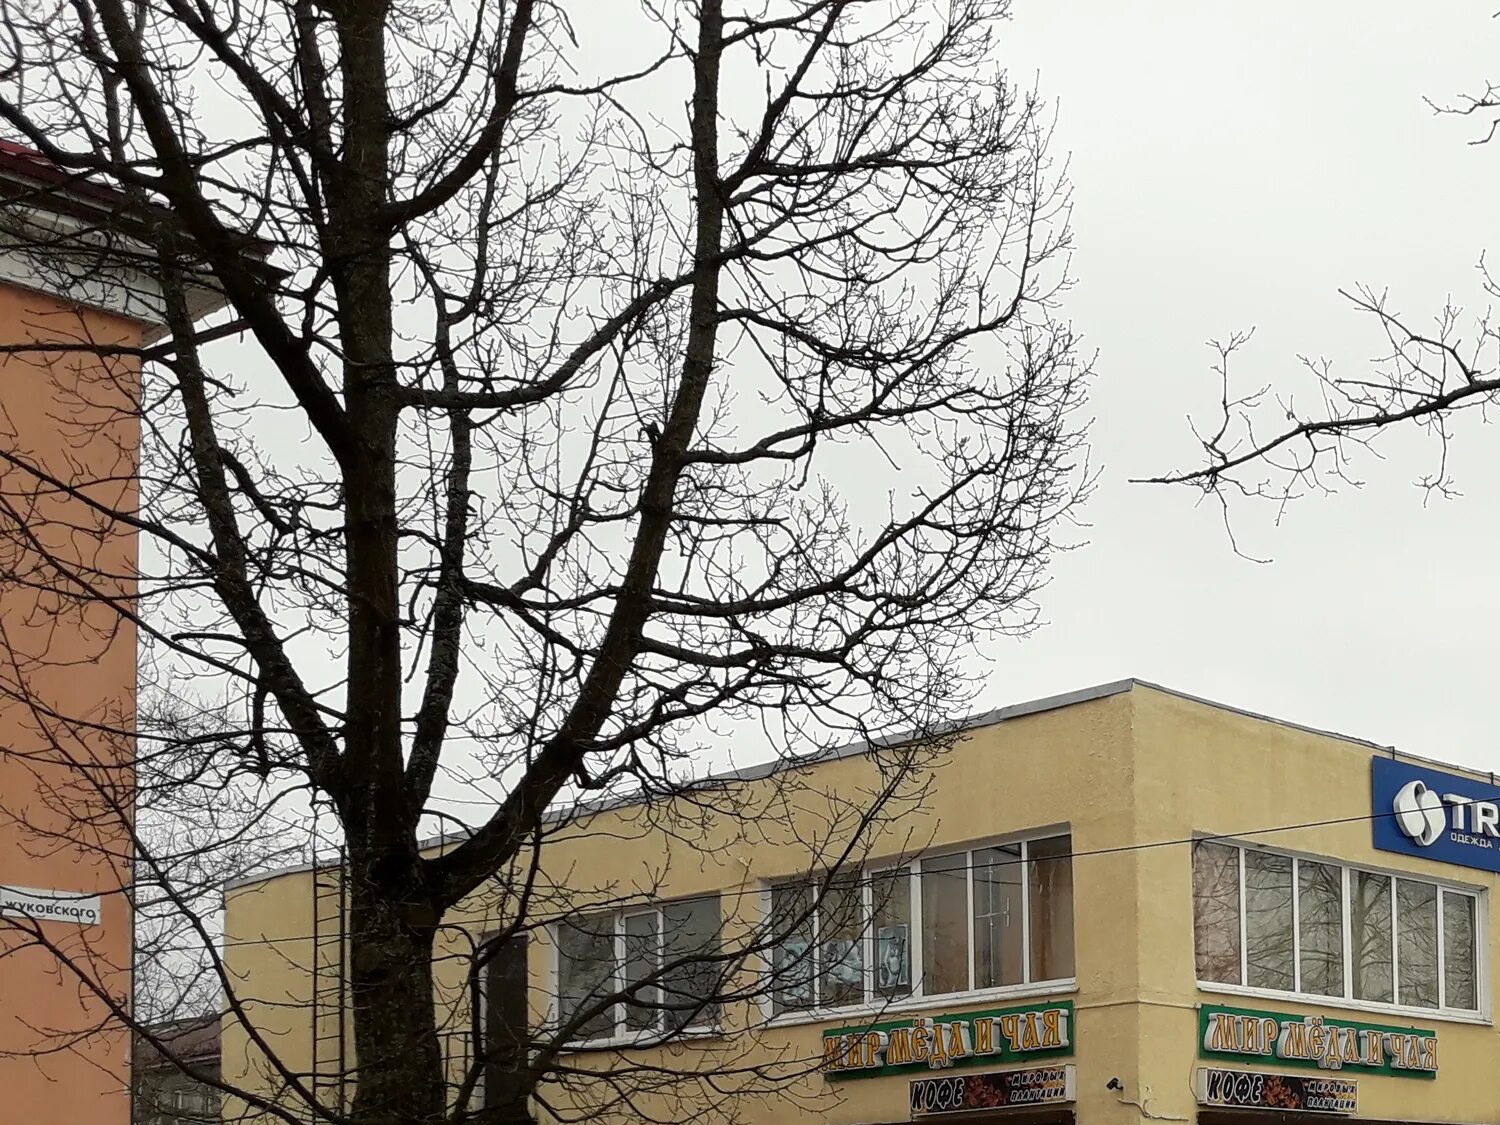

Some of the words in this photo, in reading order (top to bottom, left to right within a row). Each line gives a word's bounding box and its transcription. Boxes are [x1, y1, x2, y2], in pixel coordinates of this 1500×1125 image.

[1450, 832, 1493, 849] ОДЕЖДА
[5, 900, 96, 918] ЖУКОВСКОГО
[822, 1031, 882, 1072] МИР
[887, 1018, 966, 1068] МЁДА
[974, 1016, 994, 1056] И
[1001, 1009, 1061, 1051] ЧАЯ
[1211, 1013, 1279, 1054] МИР
[1284, 1018, 1360, 1069] МЁДА
[1367, 1030, 1385, 1066] И
[1391, 1034, 1439, 1071] ЧАЯ
[1011, 1071, 1066, 1086] МИРОВЫХ
[1208, 1071, 1265, 1103] КОФЕ
[911, 1078, 965, 1111] КОФЕ
[1010, 1086, 1066, 1103] ПЛАНТАЦИЙ
[1307, 1082, 1357, 1095] МИРОВЫХ
[1306, 1096, 1357, 1110] ПЛАНТАЦИЙ
